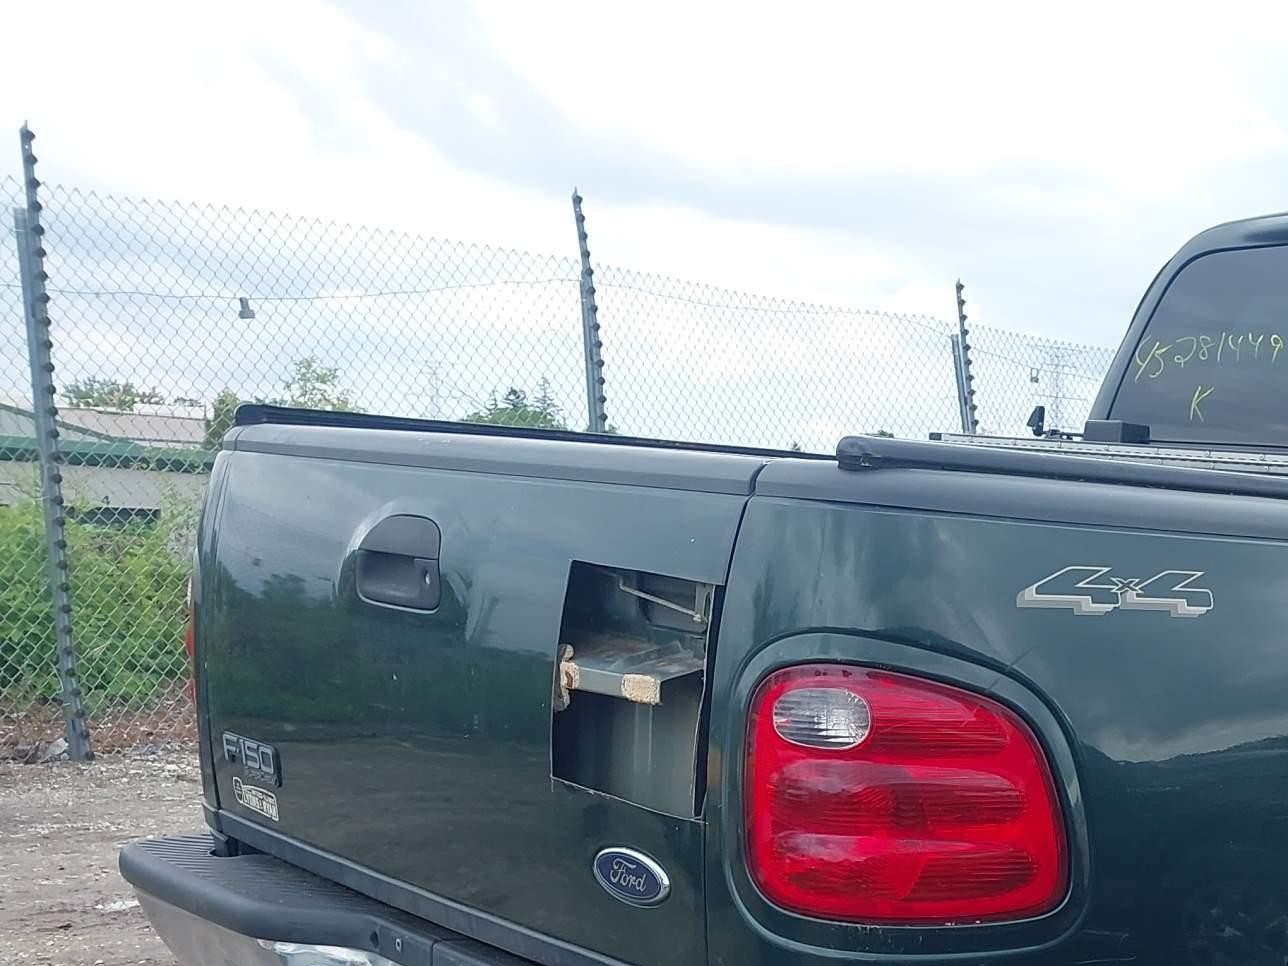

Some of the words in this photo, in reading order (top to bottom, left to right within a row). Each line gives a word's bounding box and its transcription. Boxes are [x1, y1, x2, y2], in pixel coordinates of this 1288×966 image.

[1135, 331, 1284, 383] 45281449
[1189, 385, 1215, 422] K
[610, 858, 647, 892] Ford
